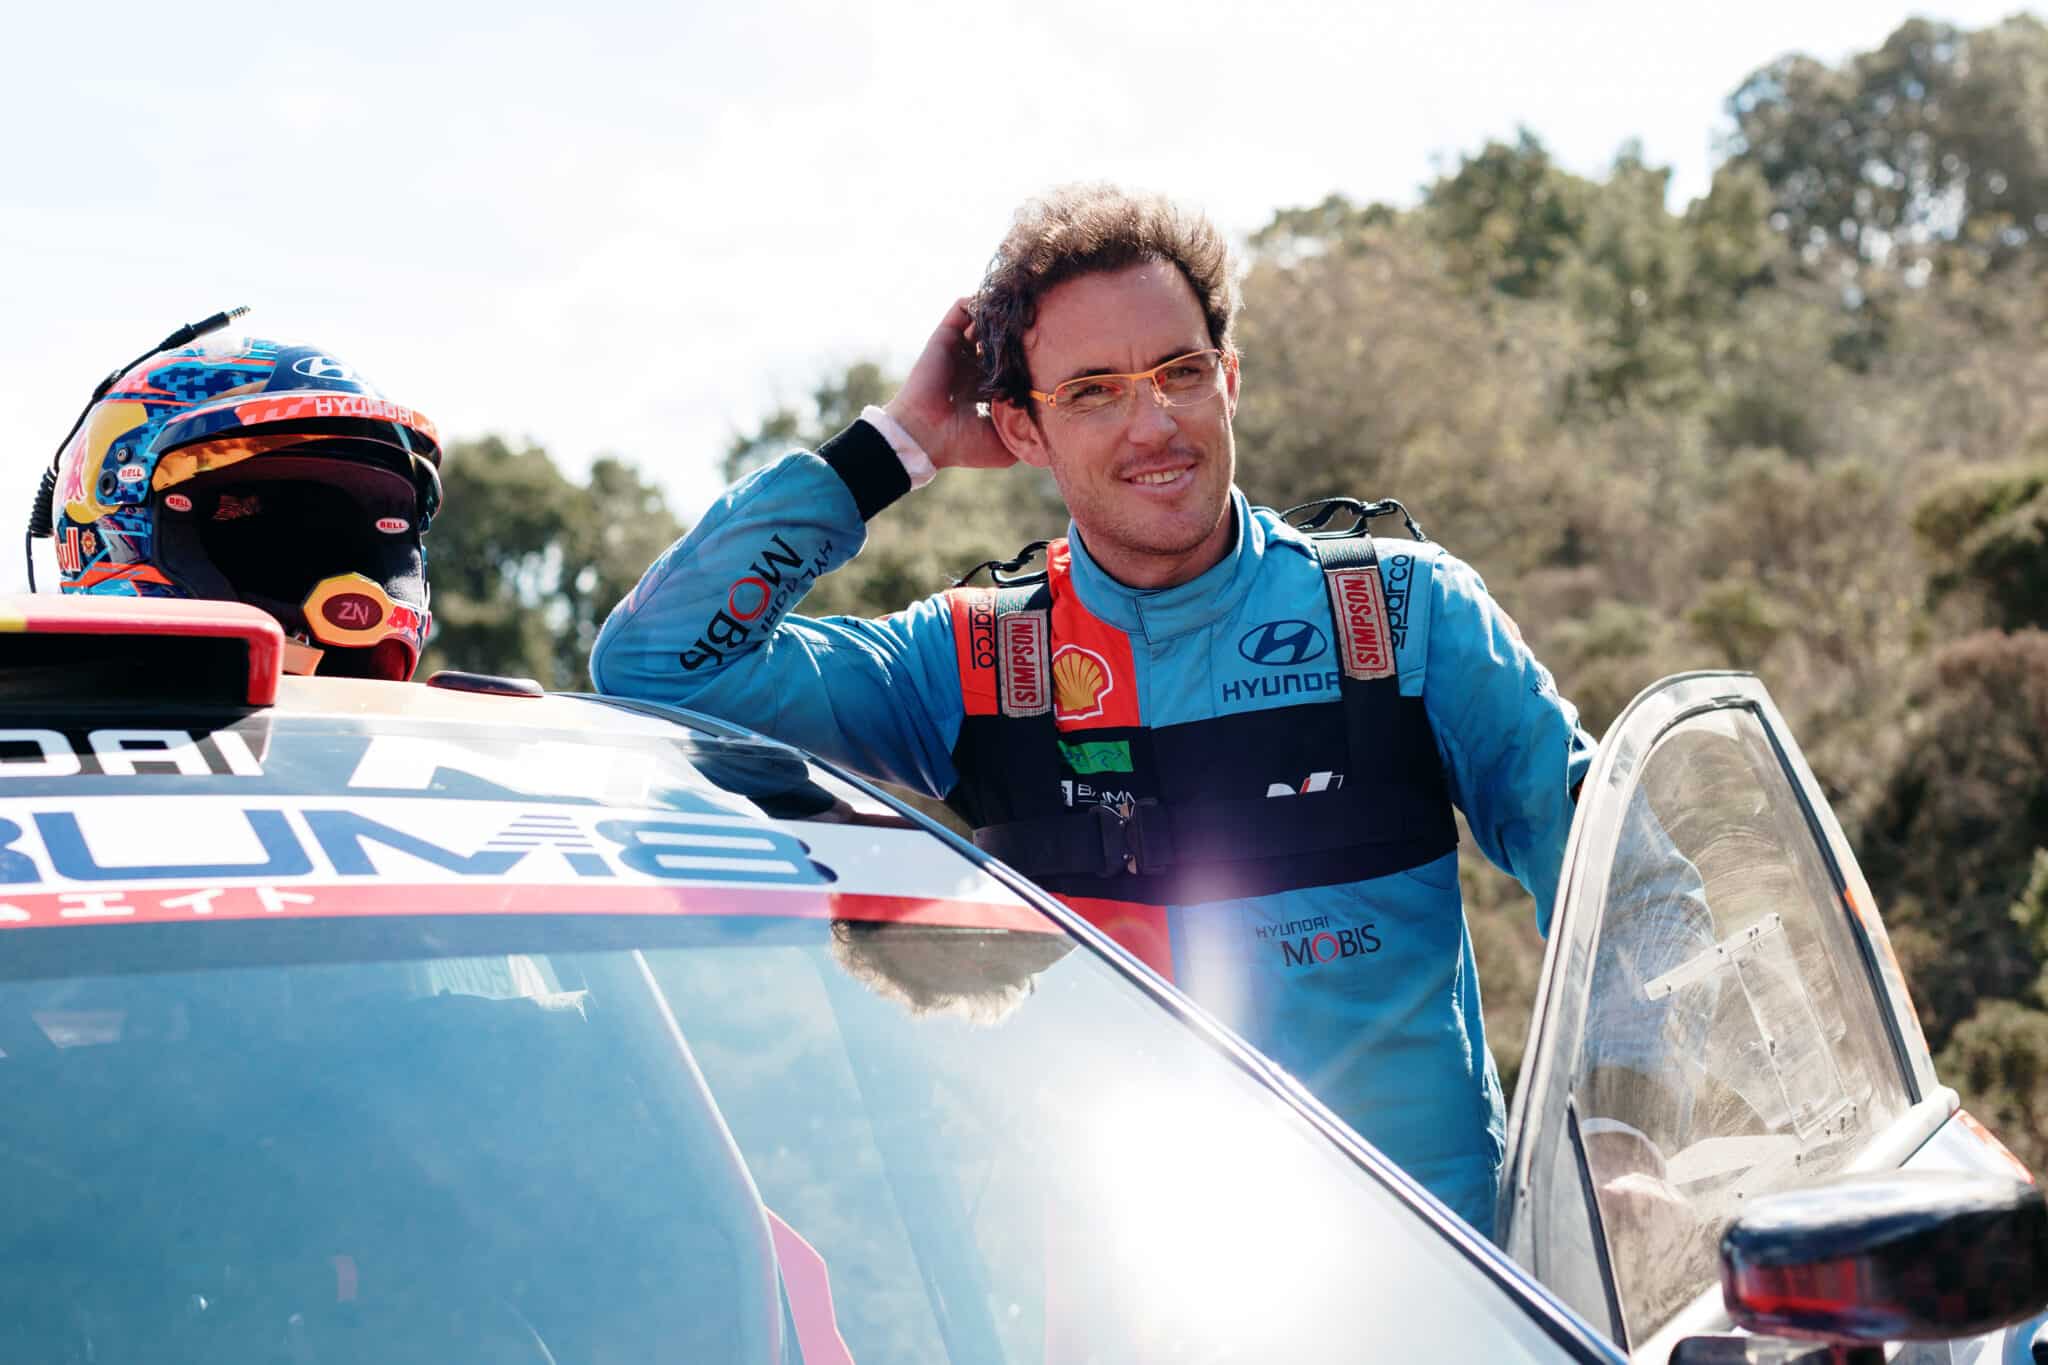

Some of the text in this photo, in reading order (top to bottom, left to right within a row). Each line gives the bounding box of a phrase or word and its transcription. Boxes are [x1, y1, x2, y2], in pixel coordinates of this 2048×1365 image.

[120, 468, 143, 478] BELL
[169, 496, 190, 508] BELL
[379, 521, 405, 529] BELL
[337, 602, 369, 625] ZN
[679, 533, 804, 671] MOBIS
[1343, 579, 1380, 665] SIMPSON
[1011, 623, 1037, 702] SIMPSON
[1222, 672, 1340, 702] HYUNDA
[1255, 916, 1330, 938] HYUNDAI
[1281, 924, 1382, 967] MOBIS
